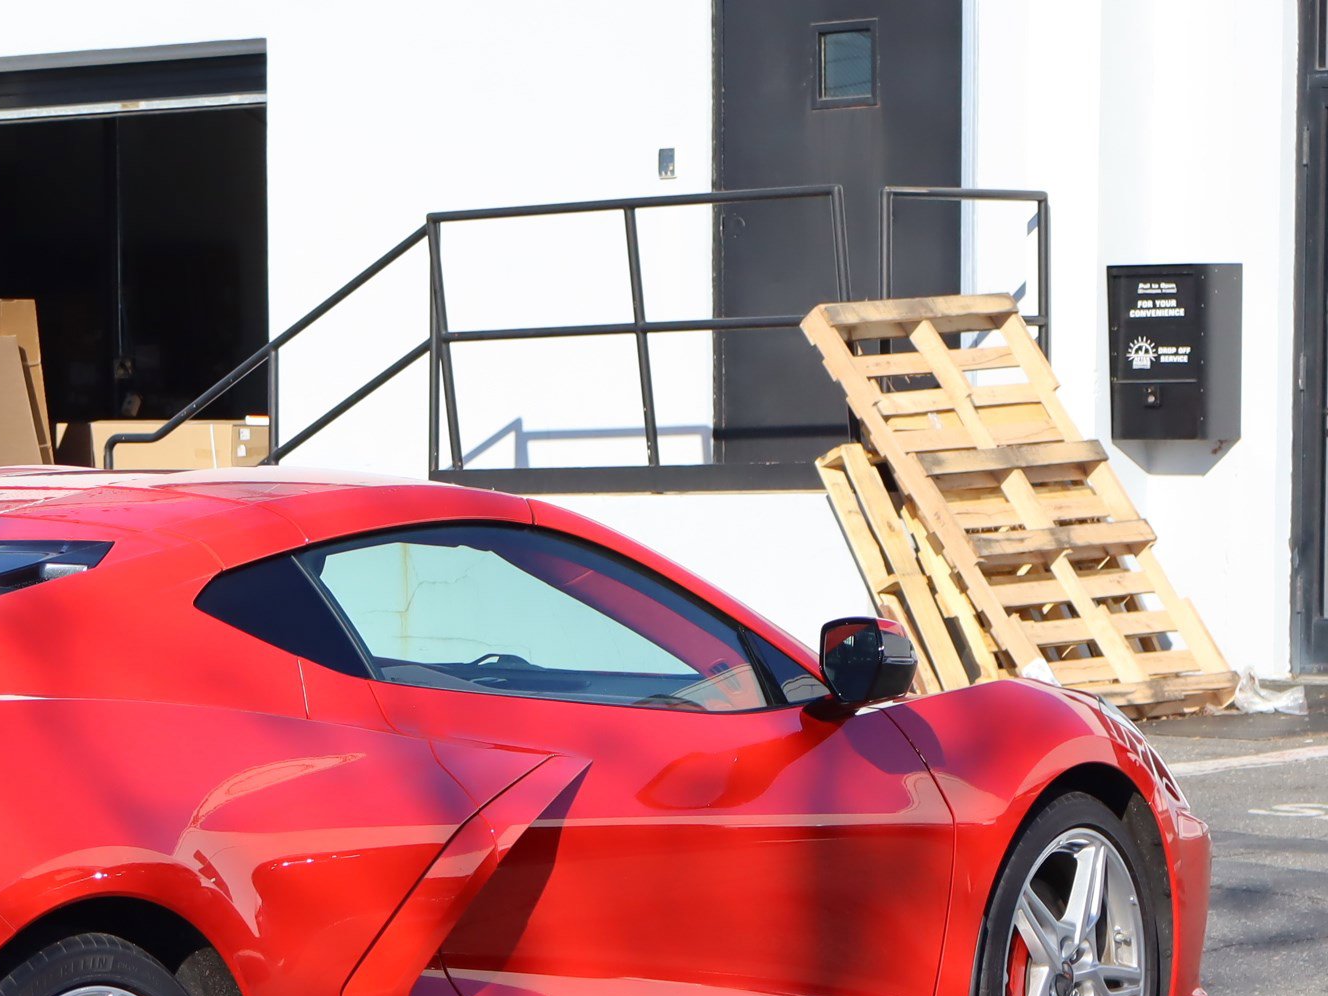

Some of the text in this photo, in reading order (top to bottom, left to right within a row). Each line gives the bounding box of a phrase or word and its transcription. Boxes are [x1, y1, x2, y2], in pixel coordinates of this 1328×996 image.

[1137, 299, 1177, 308] FOR YOUR
[1129, 308, 1185, 318] CONVENIENCE
[1157, 346, 1191, 354] DROP OFF
[1160, 355, 1188, 363] SERVICE
